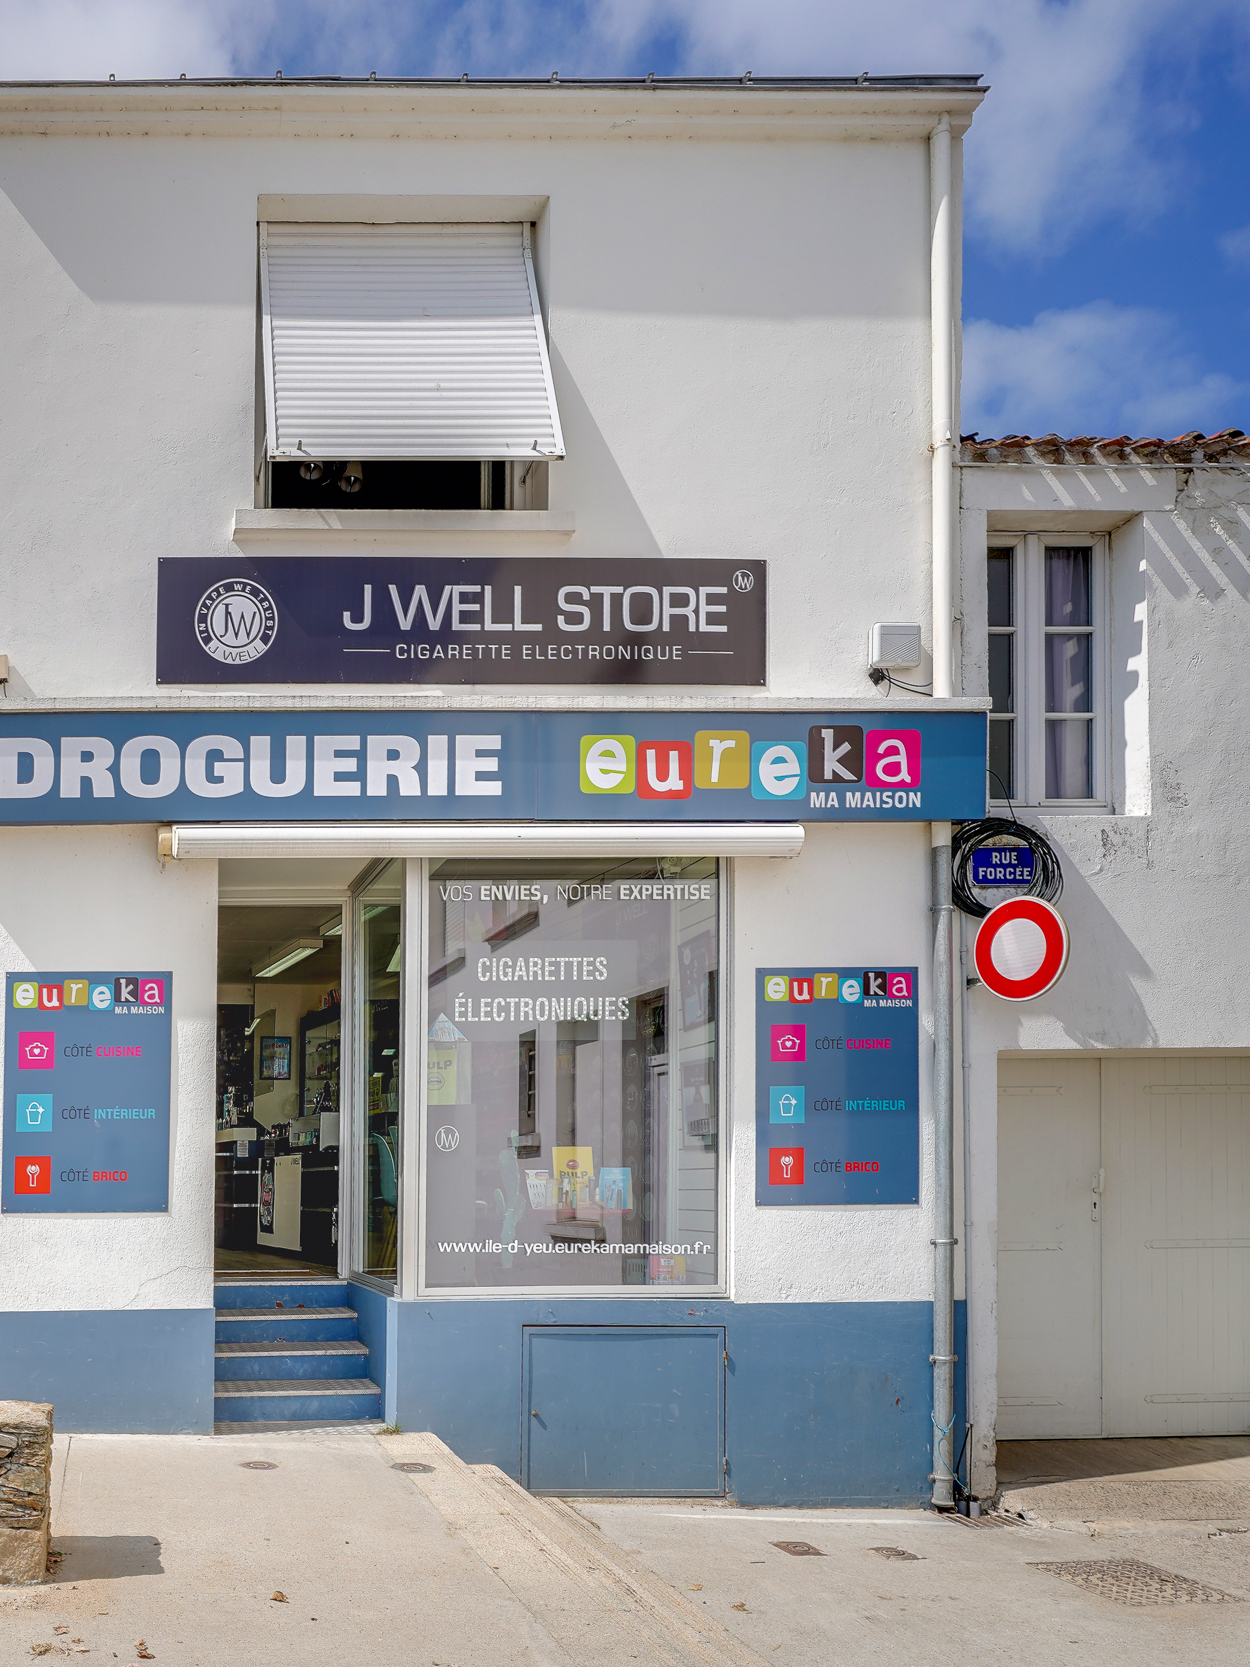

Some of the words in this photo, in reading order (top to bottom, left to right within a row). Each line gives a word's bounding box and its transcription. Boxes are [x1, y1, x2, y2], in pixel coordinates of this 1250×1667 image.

[200, 586, 226, 614] VAPE
[233, 583, 252, 594] WE
[257, 593, 274, 636] TRUST
[343, 584, 372, 631] J
[388, 584, 542, 632] WELL
[557, 585, 728, 633] STORE
[223, 645, 266, 662] WELL
[395, 643, 512, 660] CIGARETTE
[522, 644, 683, 660] ELECTRONIQUE
[584, 727, 913, 796] eureka
[810, 791, 839, 808] MA
[845, 791, 922, 808] MAISON
[992, 851, 1018, 865] RUE
[978, 865, 1032, 880] FORCÉE
[439, 884, 473, 901] VOS
[479, 884, 549, 905] ENVIES,
[556, 884, 613, 900] NOTRE
[619, 883, 711, 900] EXPERTISE
[477, 956, 609, 982] CIGARETTES
[15, 978, 161, 1010] eureka
[766, 972, 909, 1003] eureka
[114, 1006, 129, 1015] MA
[130, 1005, 165, 1015] MAISON
[454, 991, 631, 1022] ÉLECTRONIQUES
[863, 999, 878, 1008] MA
[879, 999, 913, 1008] MAISON
[63, 1043, 93, 1057] CÔTÉ
[96, 1046, 143, 1057] CUISINE
[815, 1036, 844, 1050] CÔTÉ
[846, 1038, 892, 1050] CUISINE
[427, 1059, 453, 1071] ULP
[61, 1106, 91, 1120] CÔTÉ
[94, 1105, 156, 1120] INTÉRIEUR
[813, 1097, 842, 1111] CÔTÉ
[845, 1097, 906, 1111] INTÉRIEUR
[813, 1159, 842, 1173] CÔTÉ
[845, 1161, 880, 1173] BRICO
[60, 1168, 89, 1182] CÔTÉ
[92, 1170, 128, 1182] BRICO
[438, 1239, 711, 1256] www.ile-d-yeu.eurekamamaison.fr
